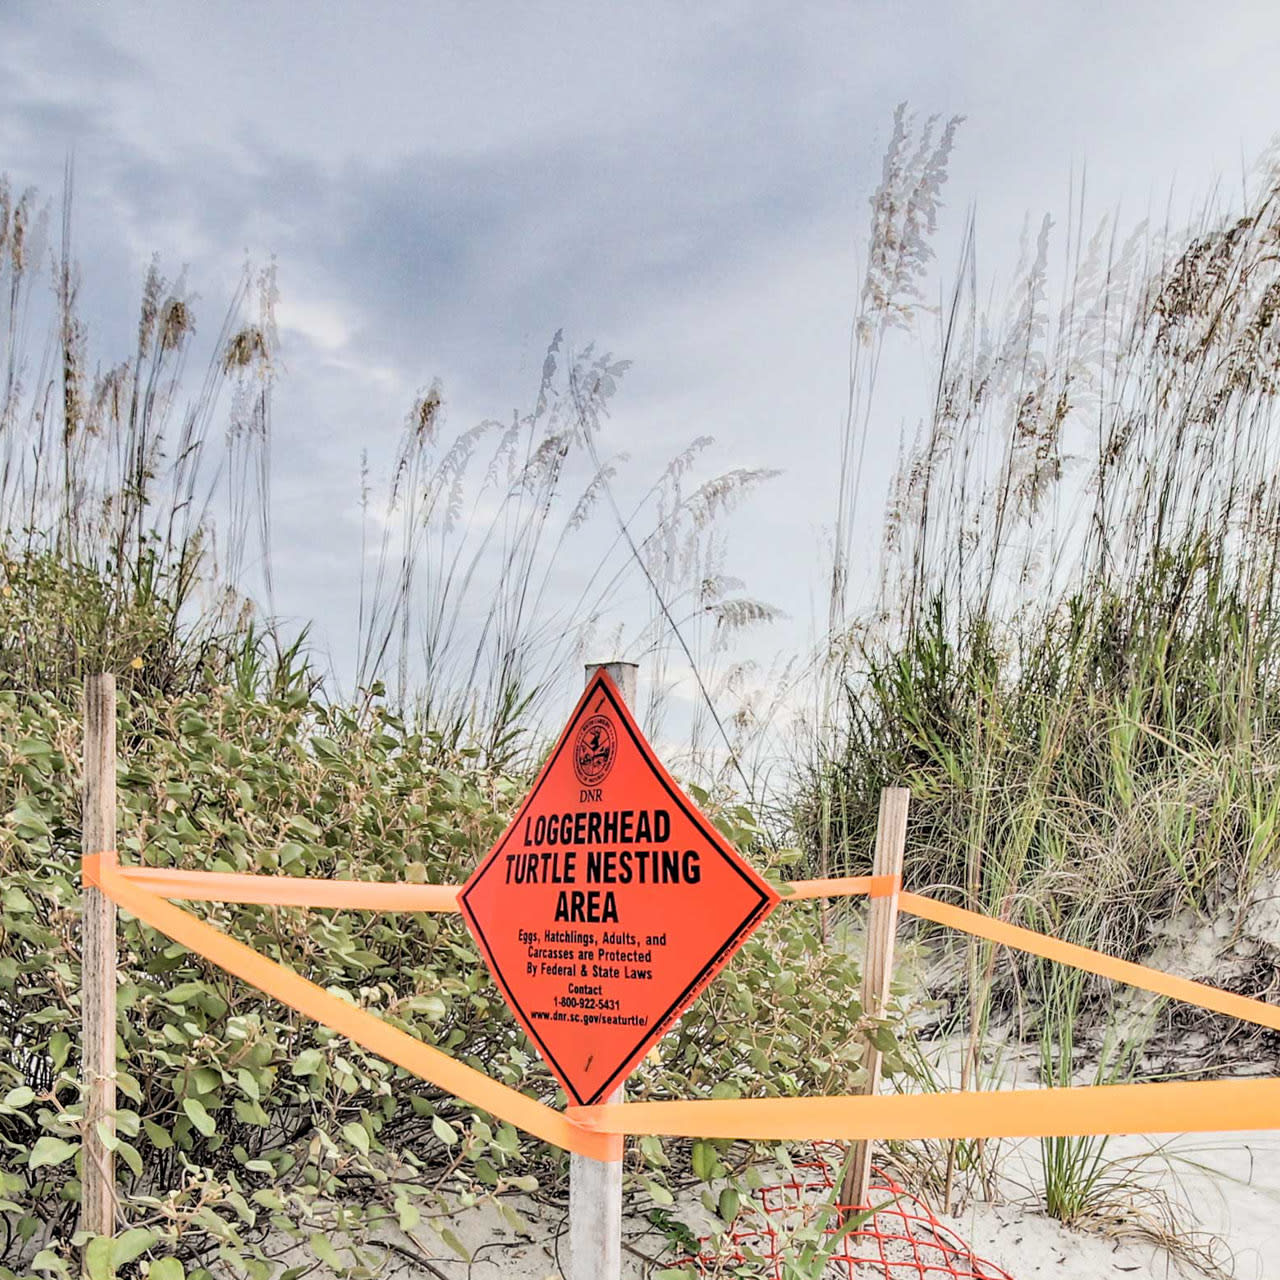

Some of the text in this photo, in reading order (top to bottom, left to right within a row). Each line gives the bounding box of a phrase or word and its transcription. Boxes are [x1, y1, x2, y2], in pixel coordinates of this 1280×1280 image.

[580, 789, 602, 802] DNR
[524, 810, 671, 846] LOGGERHEAD
[506, 850, 700, 884] TURTLE NESTING
[555, 891, 619, 923] AREA
[519, 929, 666, 947] Eggs, Hatchlings, Adults, and
[528, 946, 651, 962] Carcasses are Protected
[527, 962, 652, 979] By Federal & State Laws
[568, 983, 602, 995] Contact
[554, 997, 619, 1010] 1-800-922-5431
[531, 1009, 648, 1026] www.dnr.sc.gov/seaturtle/
